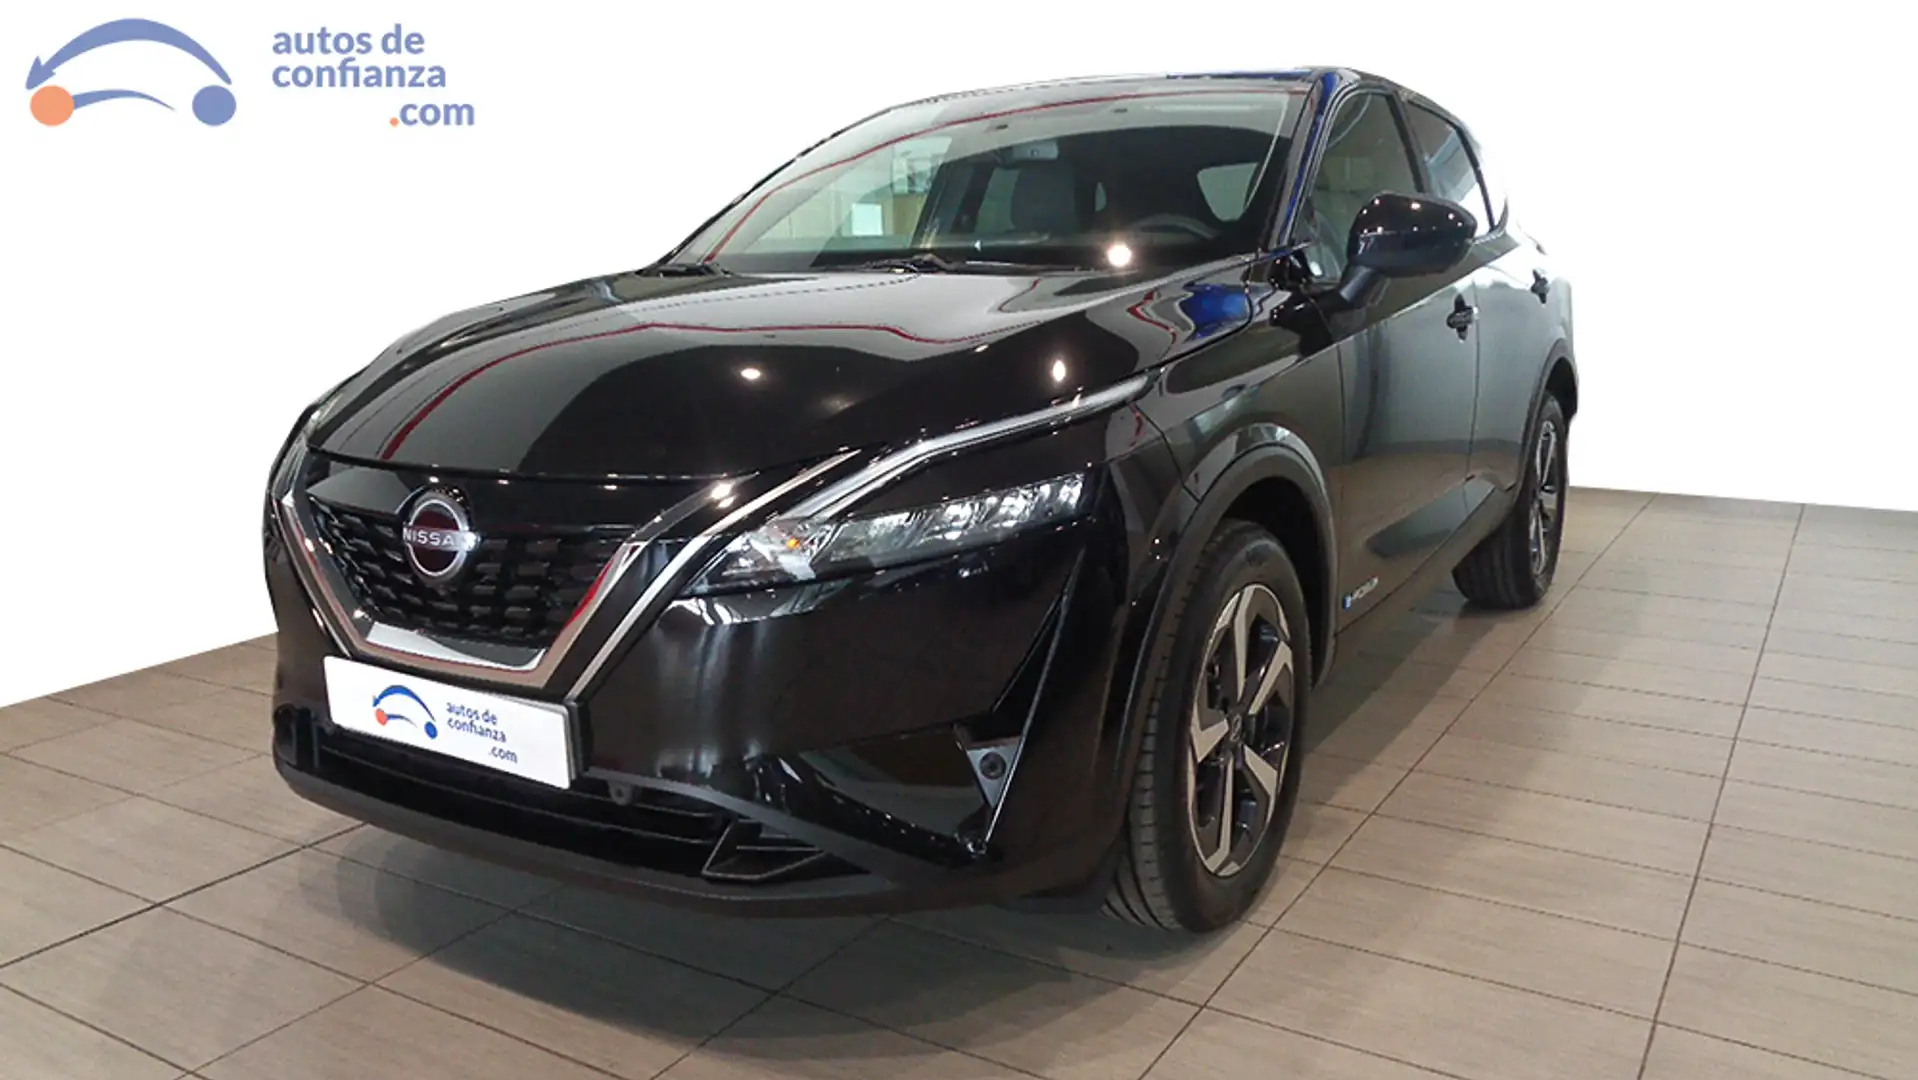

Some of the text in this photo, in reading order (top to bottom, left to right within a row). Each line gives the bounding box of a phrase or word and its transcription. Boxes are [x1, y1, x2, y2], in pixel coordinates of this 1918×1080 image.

[403, 528, 475, 550] NISSA
[446, 702, 498, 726] autos de
[447, 718, 507, 743] confianza
